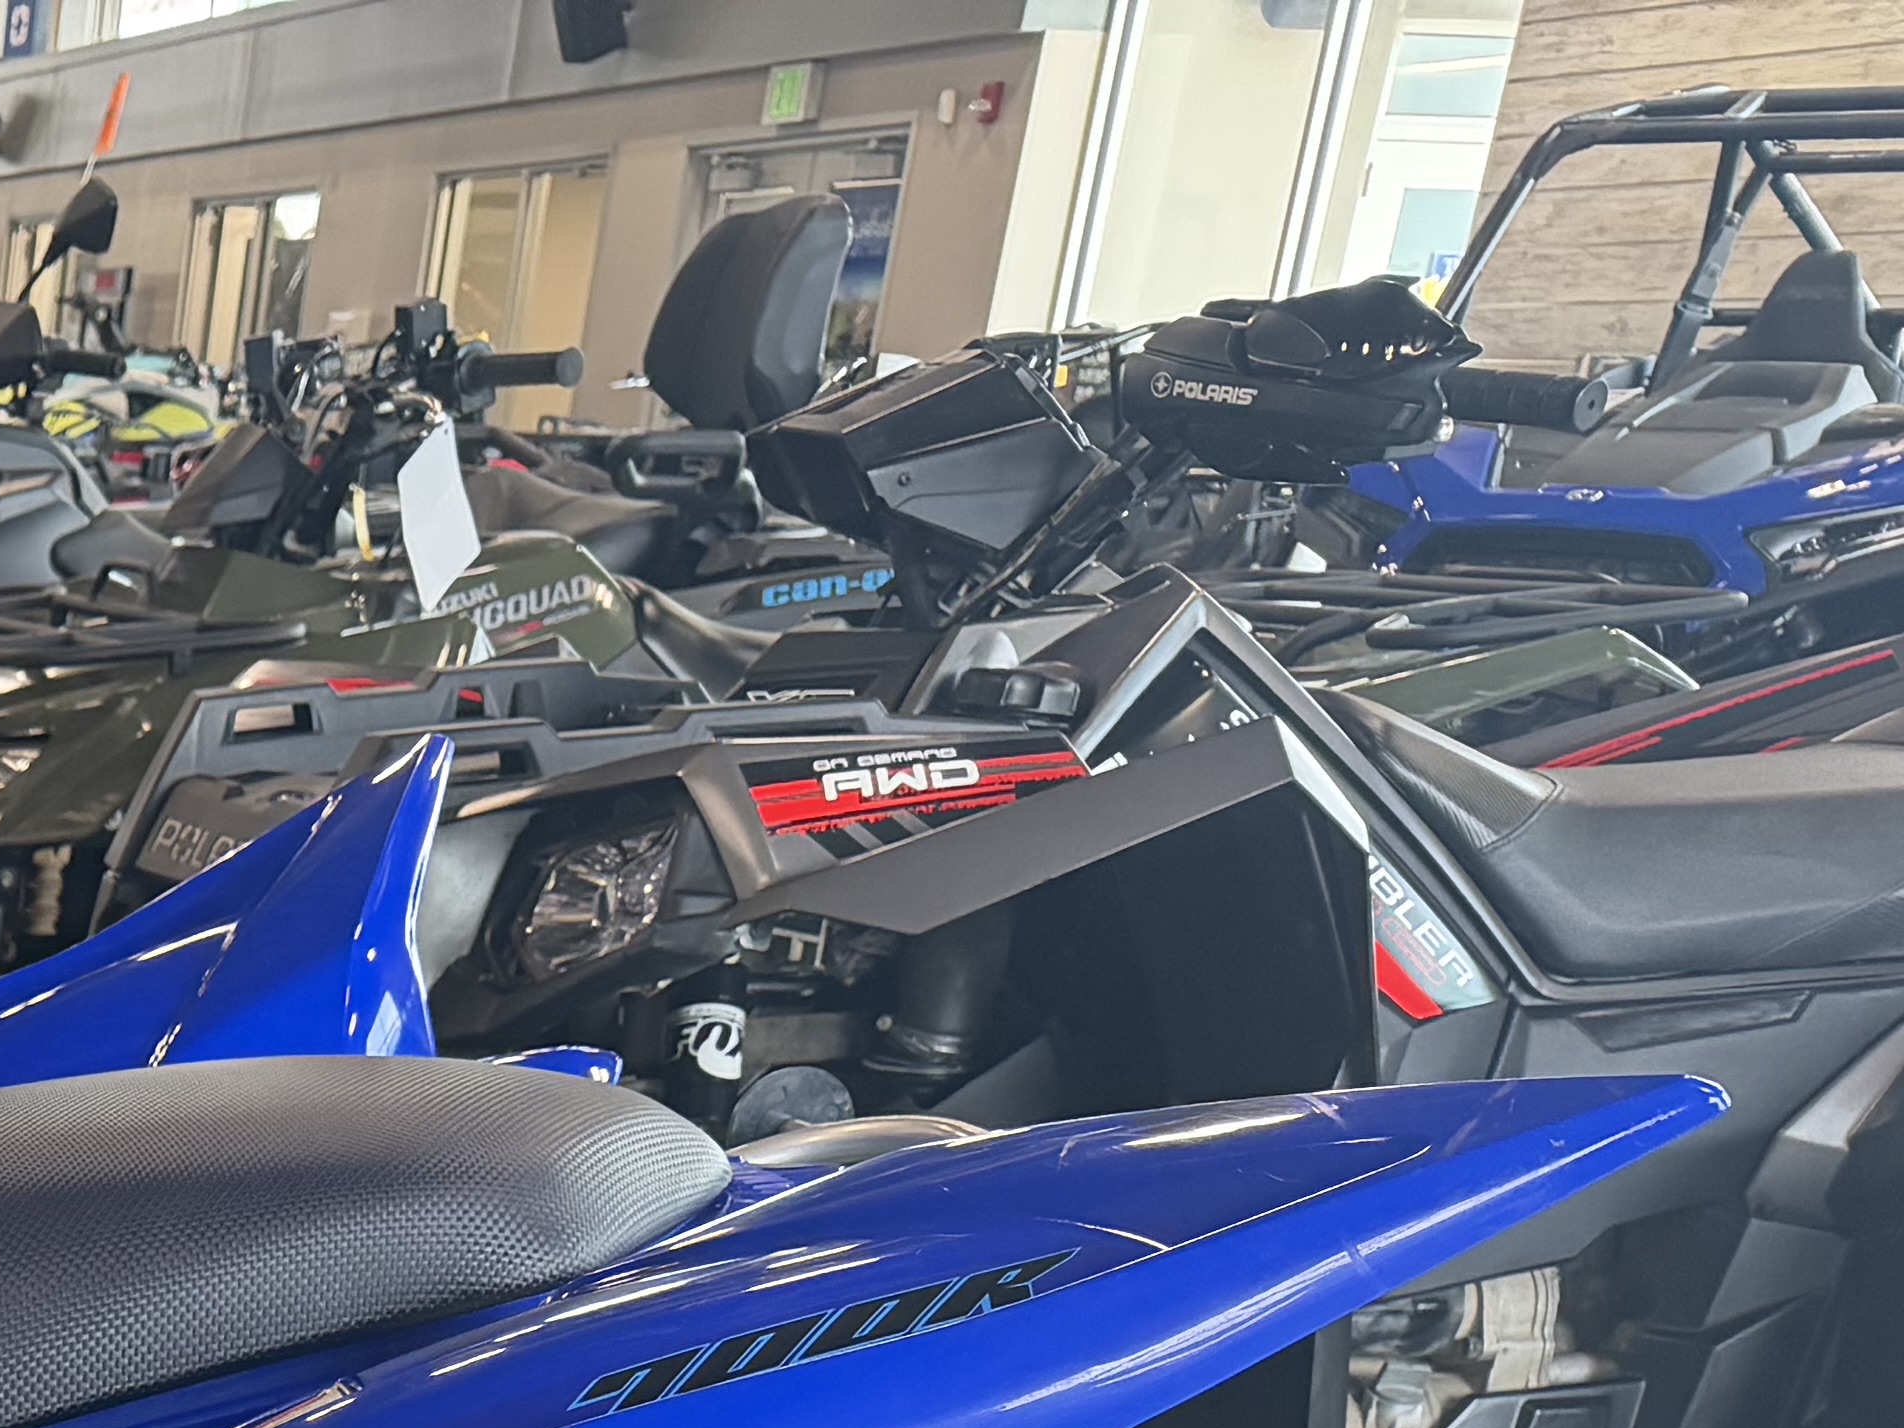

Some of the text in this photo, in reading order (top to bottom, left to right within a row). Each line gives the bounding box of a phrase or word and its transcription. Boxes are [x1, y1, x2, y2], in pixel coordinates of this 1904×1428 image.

[1173, 378, 1259, 407] POLARIS
[812, 747, 958, 772] ON DEMAND
[821, 758, 981, 802] AWD
[566, 1246, 1082, 1415] 700R
